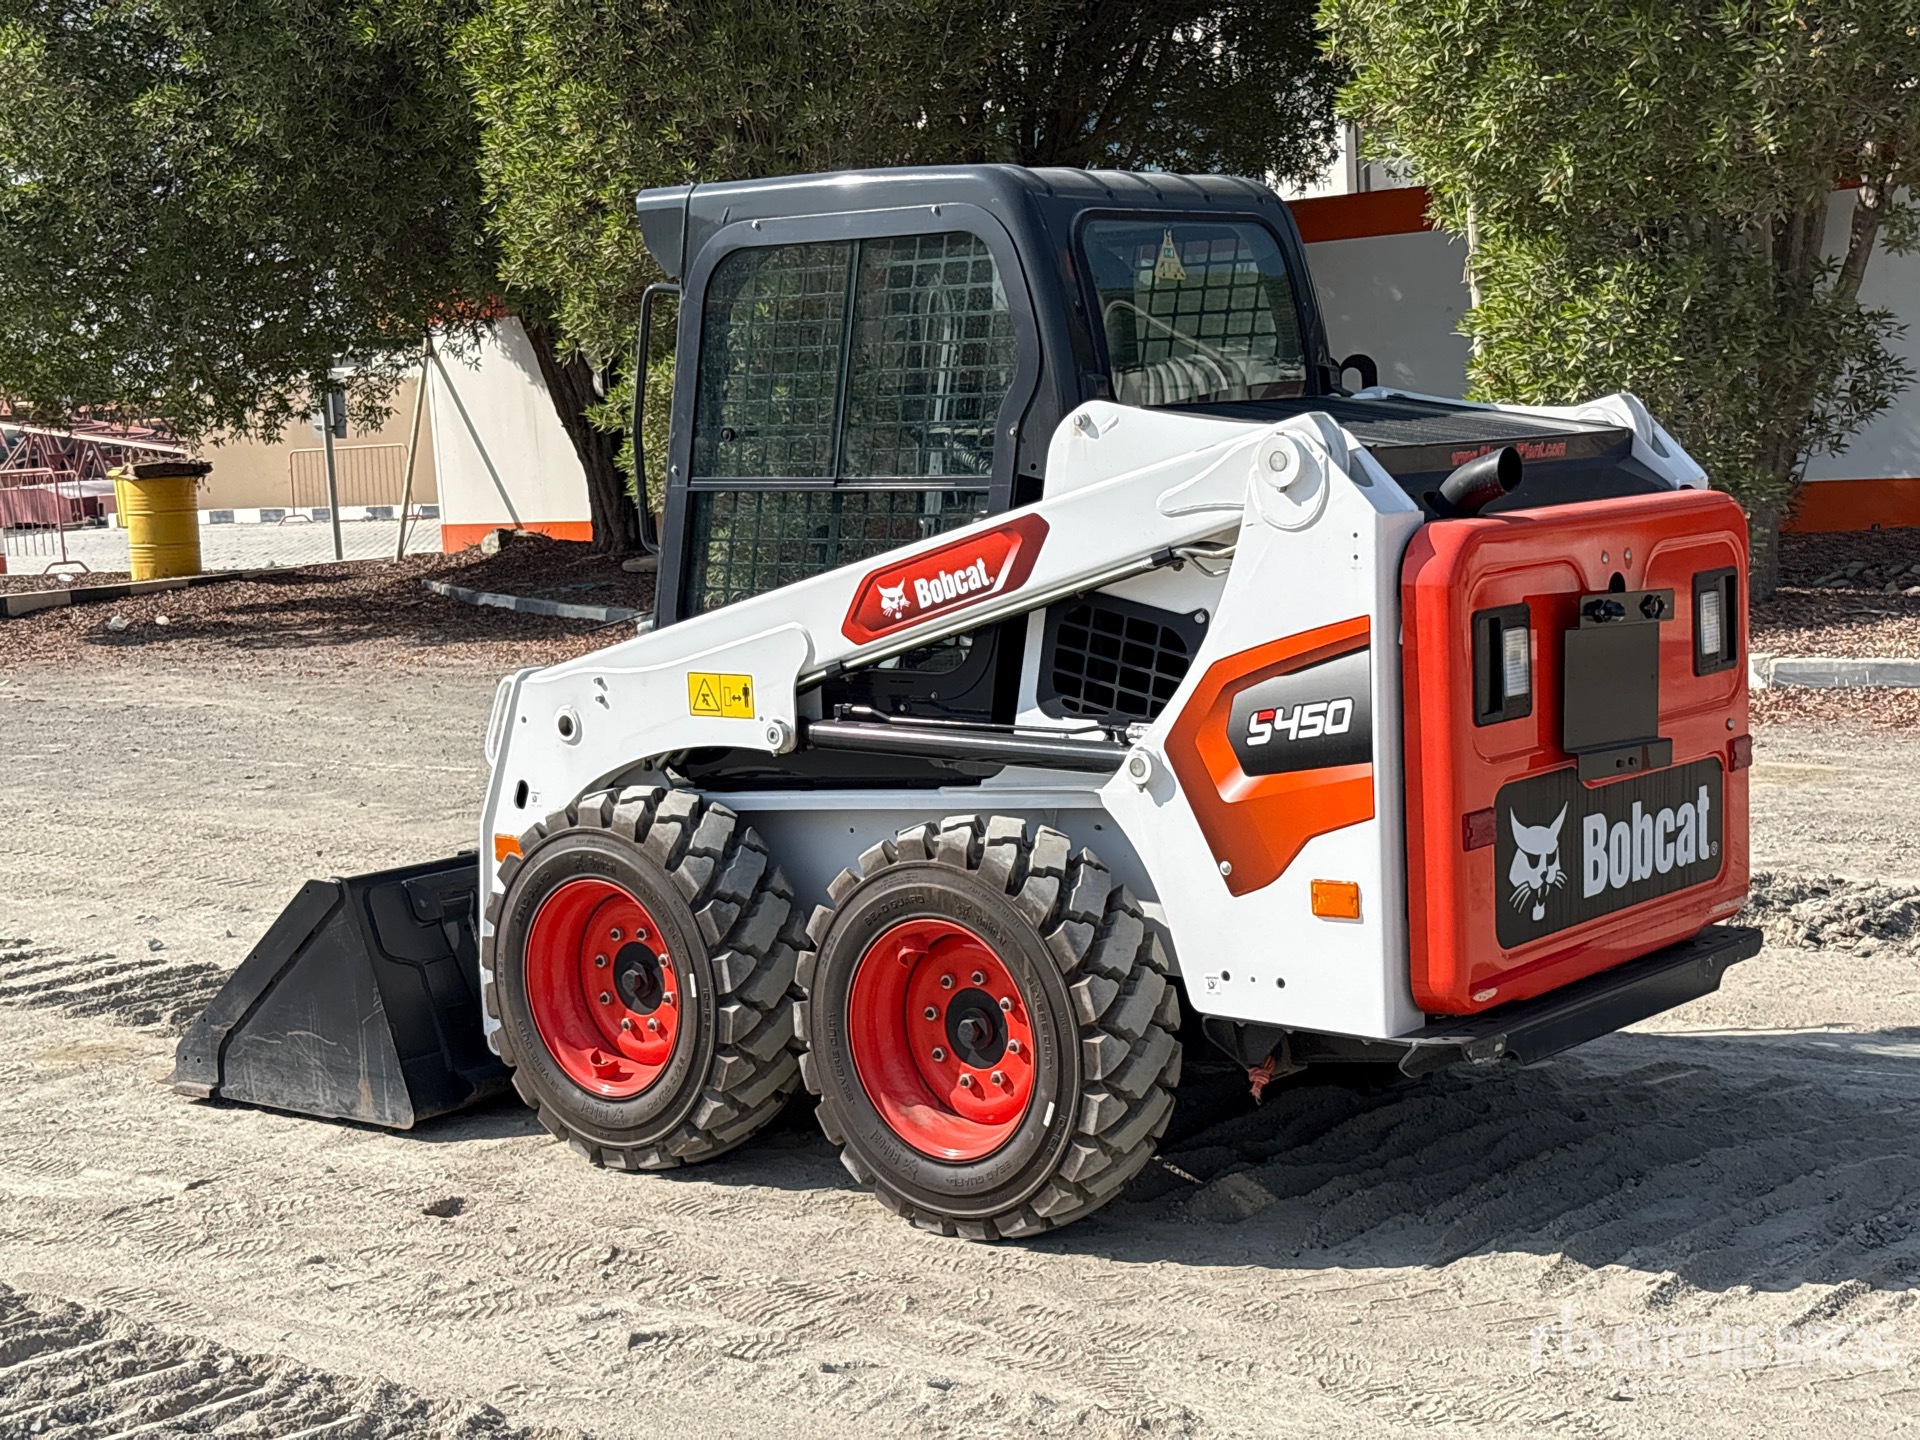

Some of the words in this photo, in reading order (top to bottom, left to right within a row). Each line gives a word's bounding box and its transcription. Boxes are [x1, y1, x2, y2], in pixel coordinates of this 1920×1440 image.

[914, 558, 990, 609] Bobcat
[1246, 698, 1354, 746] S450
[1583, 785, 1709, 899] Bobcat
[890, 894, 925, 910] GUARD
[828, 1013, 838, 1046] DUTY
[1043, 1034, 1052, 1070] DUTY
[832, 1048, 854, 1102] SEVERE
